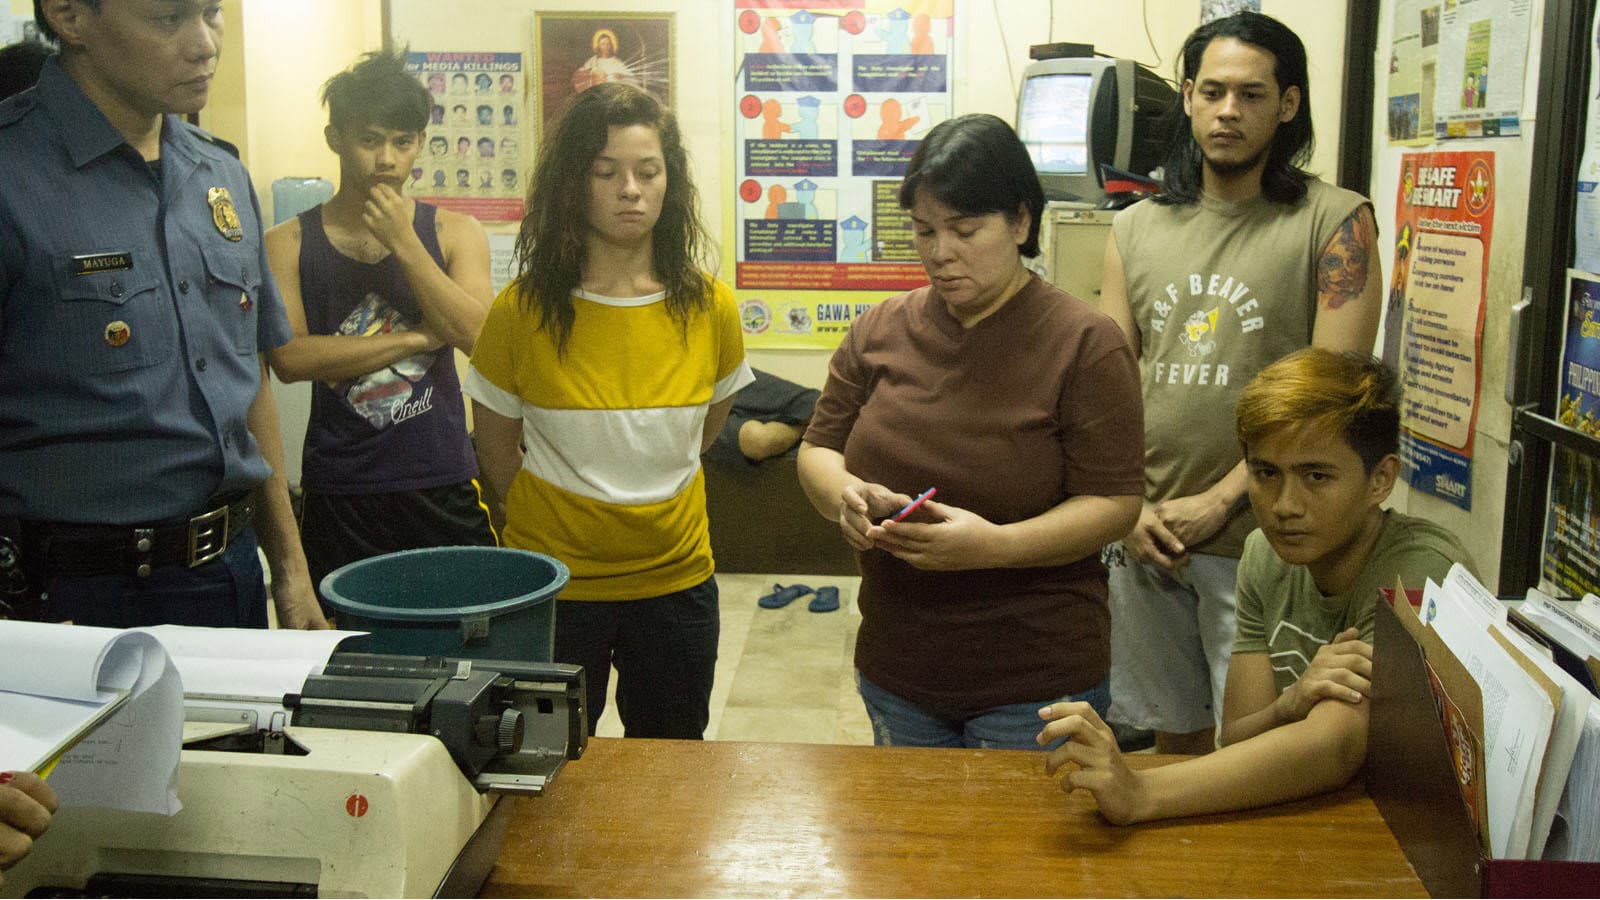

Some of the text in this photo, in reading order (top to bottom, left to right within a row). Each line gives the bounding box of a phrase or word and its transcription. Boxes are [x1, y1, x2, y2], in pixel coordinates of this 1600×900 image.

[422, 62, 460, 71] MEDIA
[463, 62, 519, 71] KILLINGS
[426, 53, 496, 62] WANTED
[83, 256, 126, 269] MAYUGA
[817, 303, 851, 321] GAWA
[1189, 273, 1264, 334] BEAVER
[1155, 362, 1229, 386] FEVER
[1435, 474, 1467, 498] SMART
